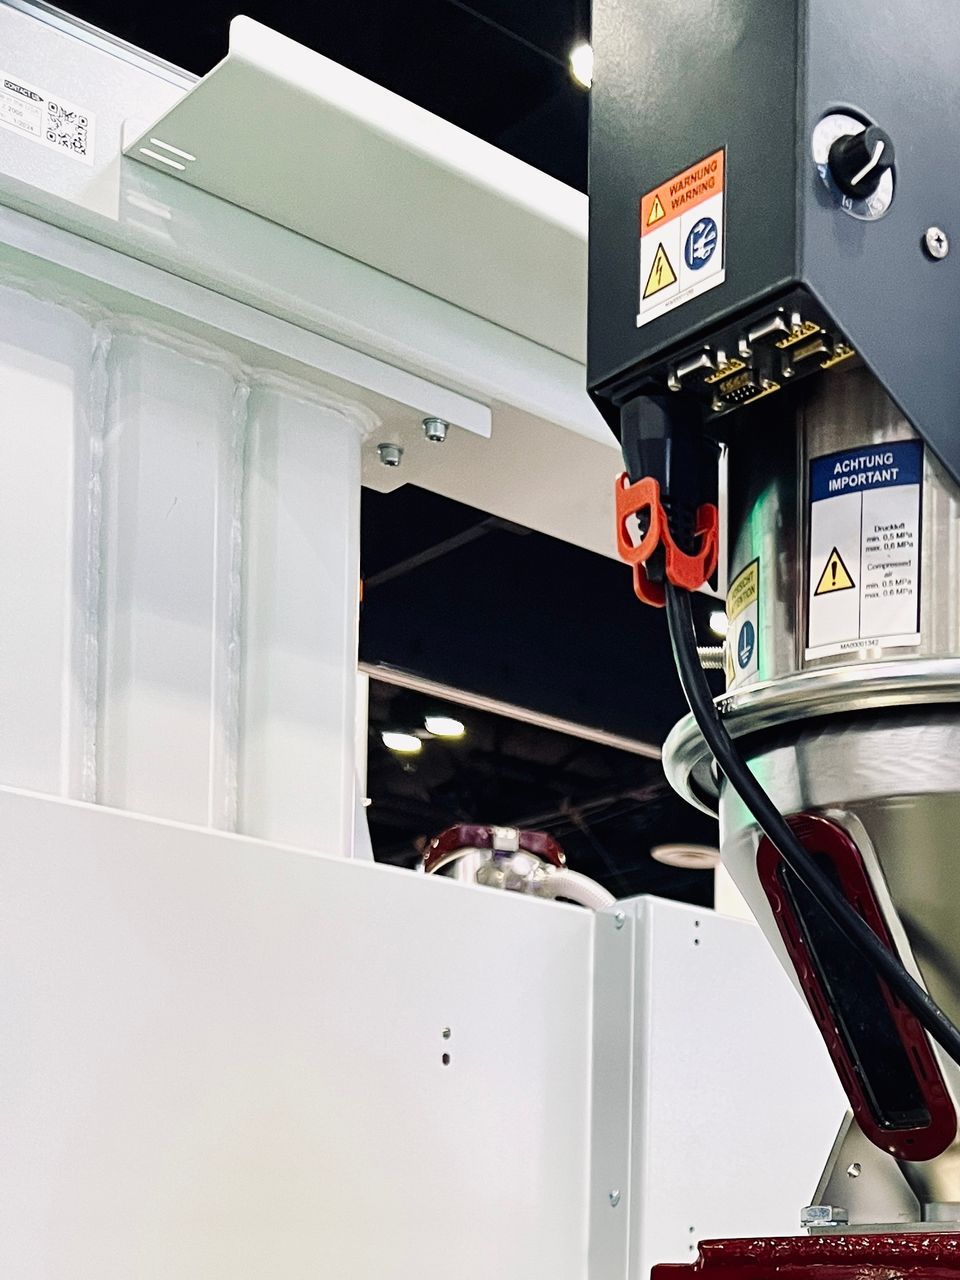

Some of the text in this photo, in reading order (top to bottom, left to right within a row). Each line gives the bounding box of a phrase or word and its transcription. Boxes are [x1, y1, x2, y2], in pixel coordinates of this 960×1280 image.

[669, 160, 718, 196] WARNUNG
[671, 177, 716, 210] WARNING
[833, 452, 894, 475] ACHTUNG
[828, 468, 899, 492] IMPORTANT
